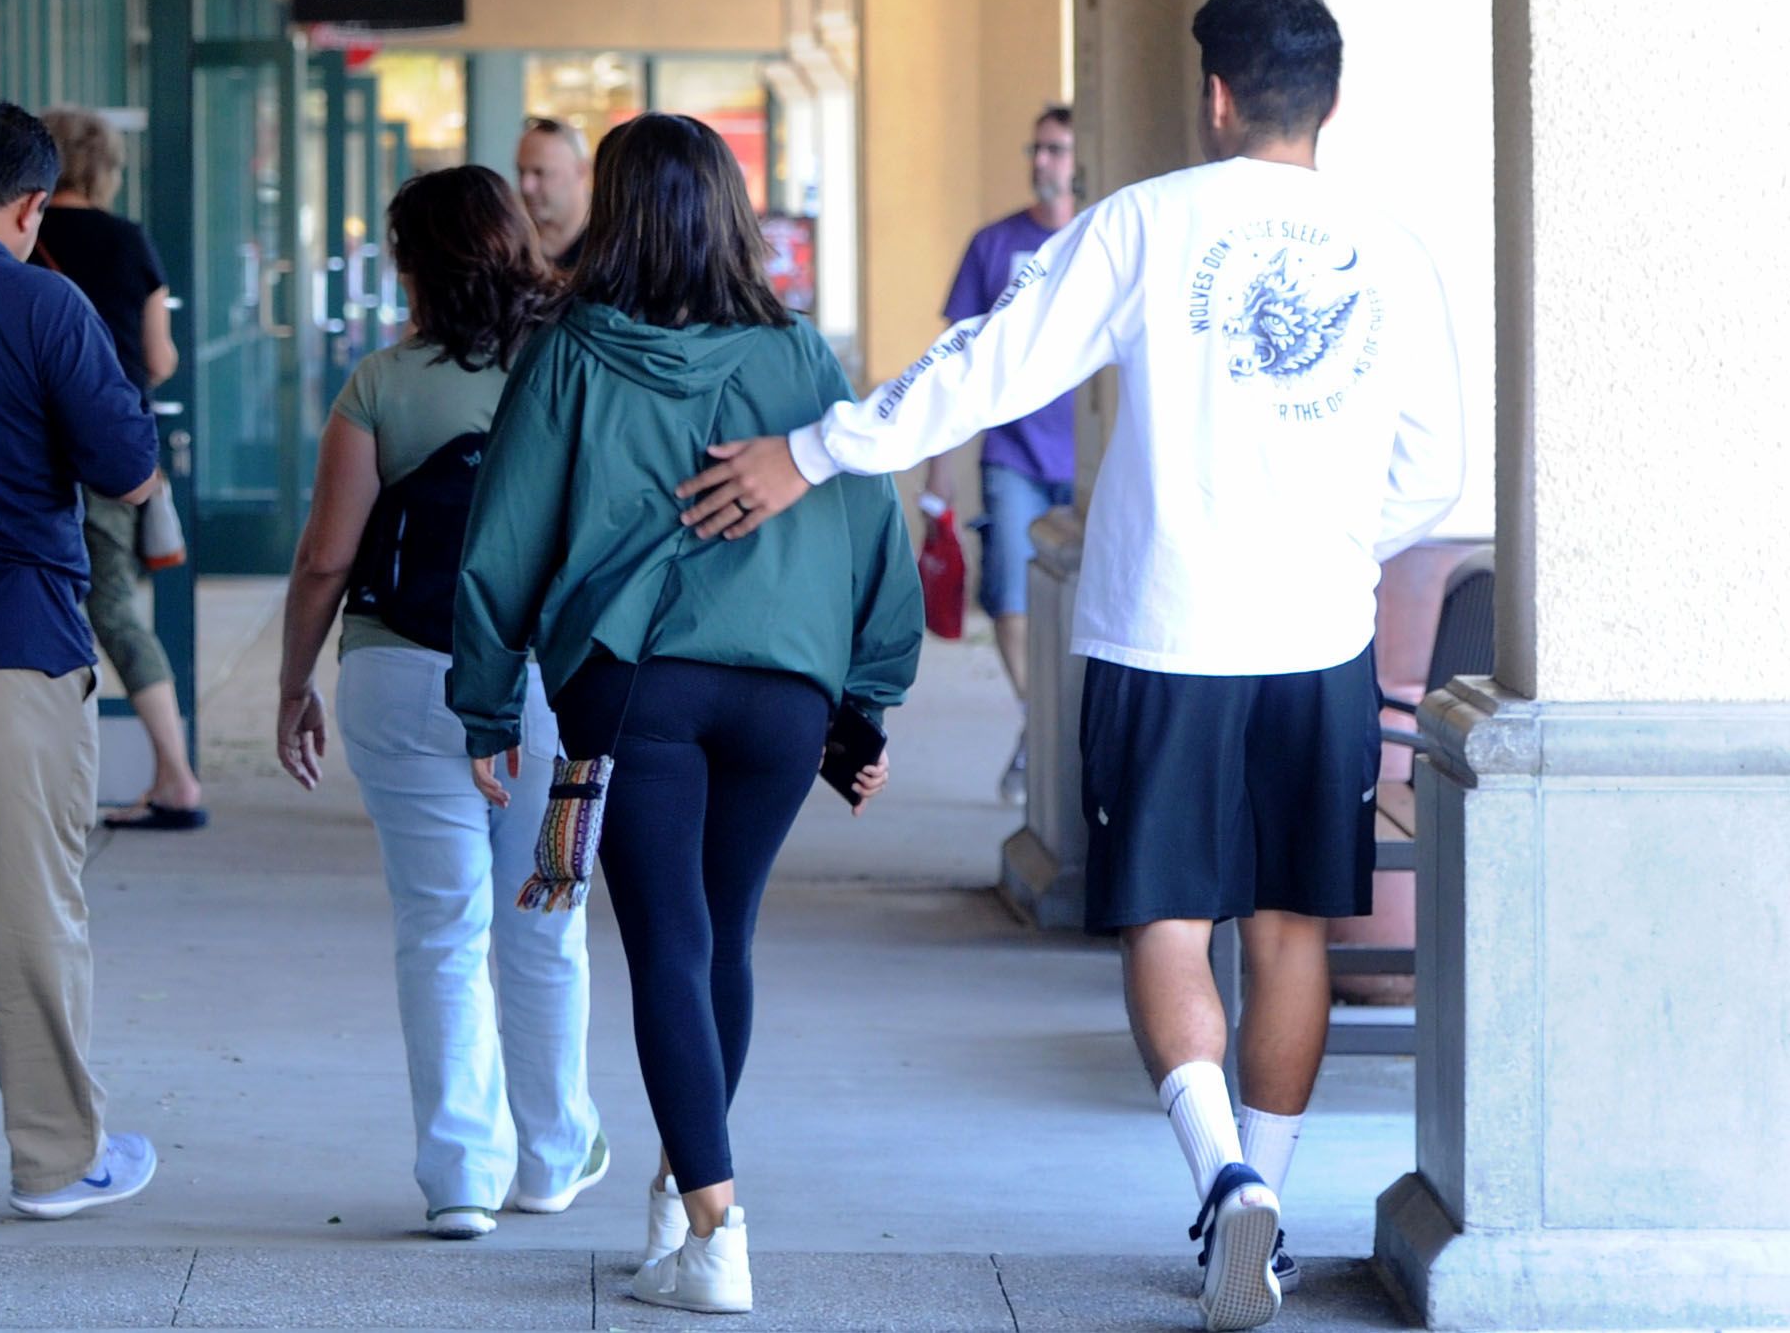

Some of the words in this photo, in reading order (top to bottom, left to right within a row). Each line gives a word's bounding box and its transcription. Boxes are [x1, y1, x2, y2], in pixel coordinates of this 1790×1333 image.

[1189, 270, 1214, 335] WOLVES
[1281, 220, 1330, 246] SLEEP
[1293, 400, 1324, 422] THE
